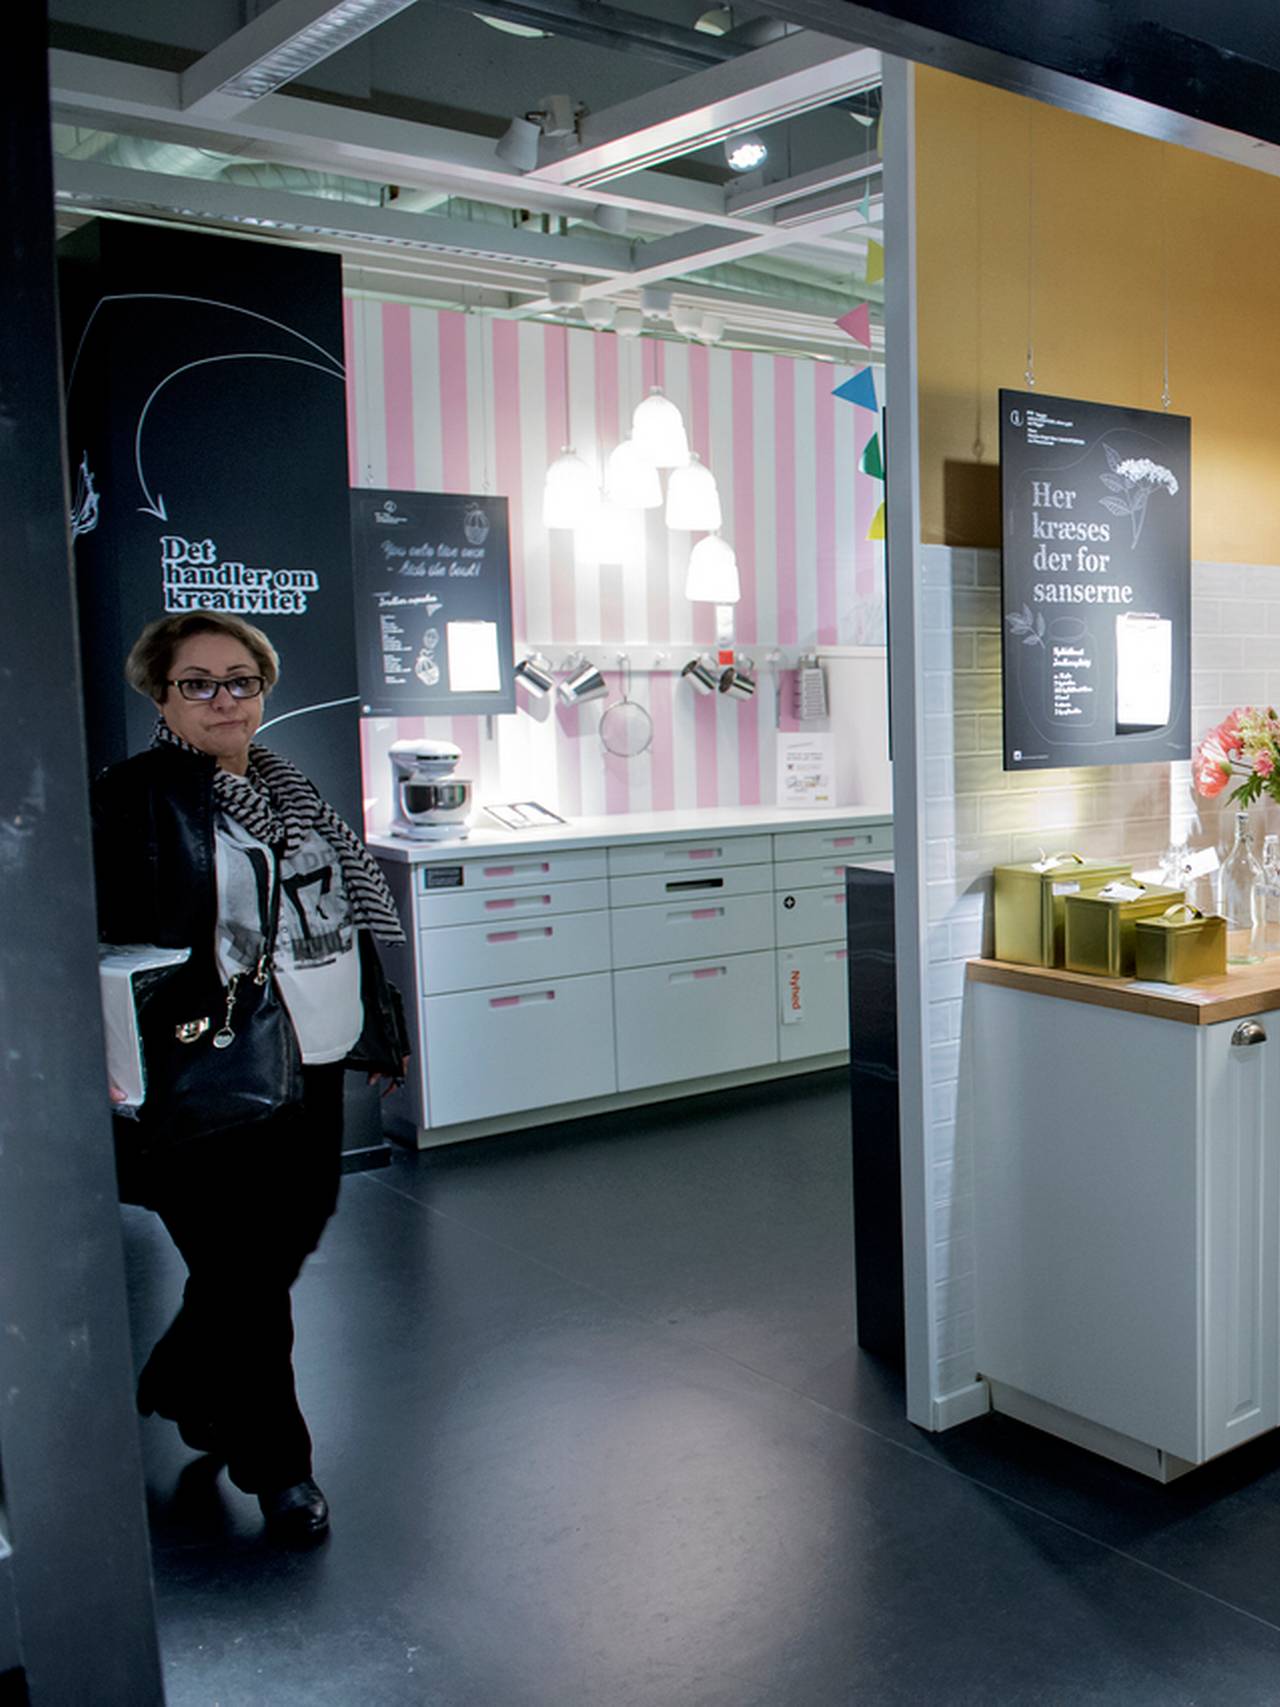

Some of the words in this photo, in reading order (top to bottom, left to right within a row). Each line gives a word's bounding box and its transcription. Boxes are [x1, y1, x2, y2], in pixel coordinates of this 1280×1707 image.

[1032, 481, 1077, 509] Her
[1032, 511, 1111, 542] kræses
[160, 536, 216, 564] Det
[1033, 544, 1072, 571] der
[1076, 545, 1111, 572] for
[162, 562, 272, 589] handler
[272, 570, 319, 591] om
[164, 587, 307, 613] kreativitet
[1033, 583, 1134, 604] sanserne
